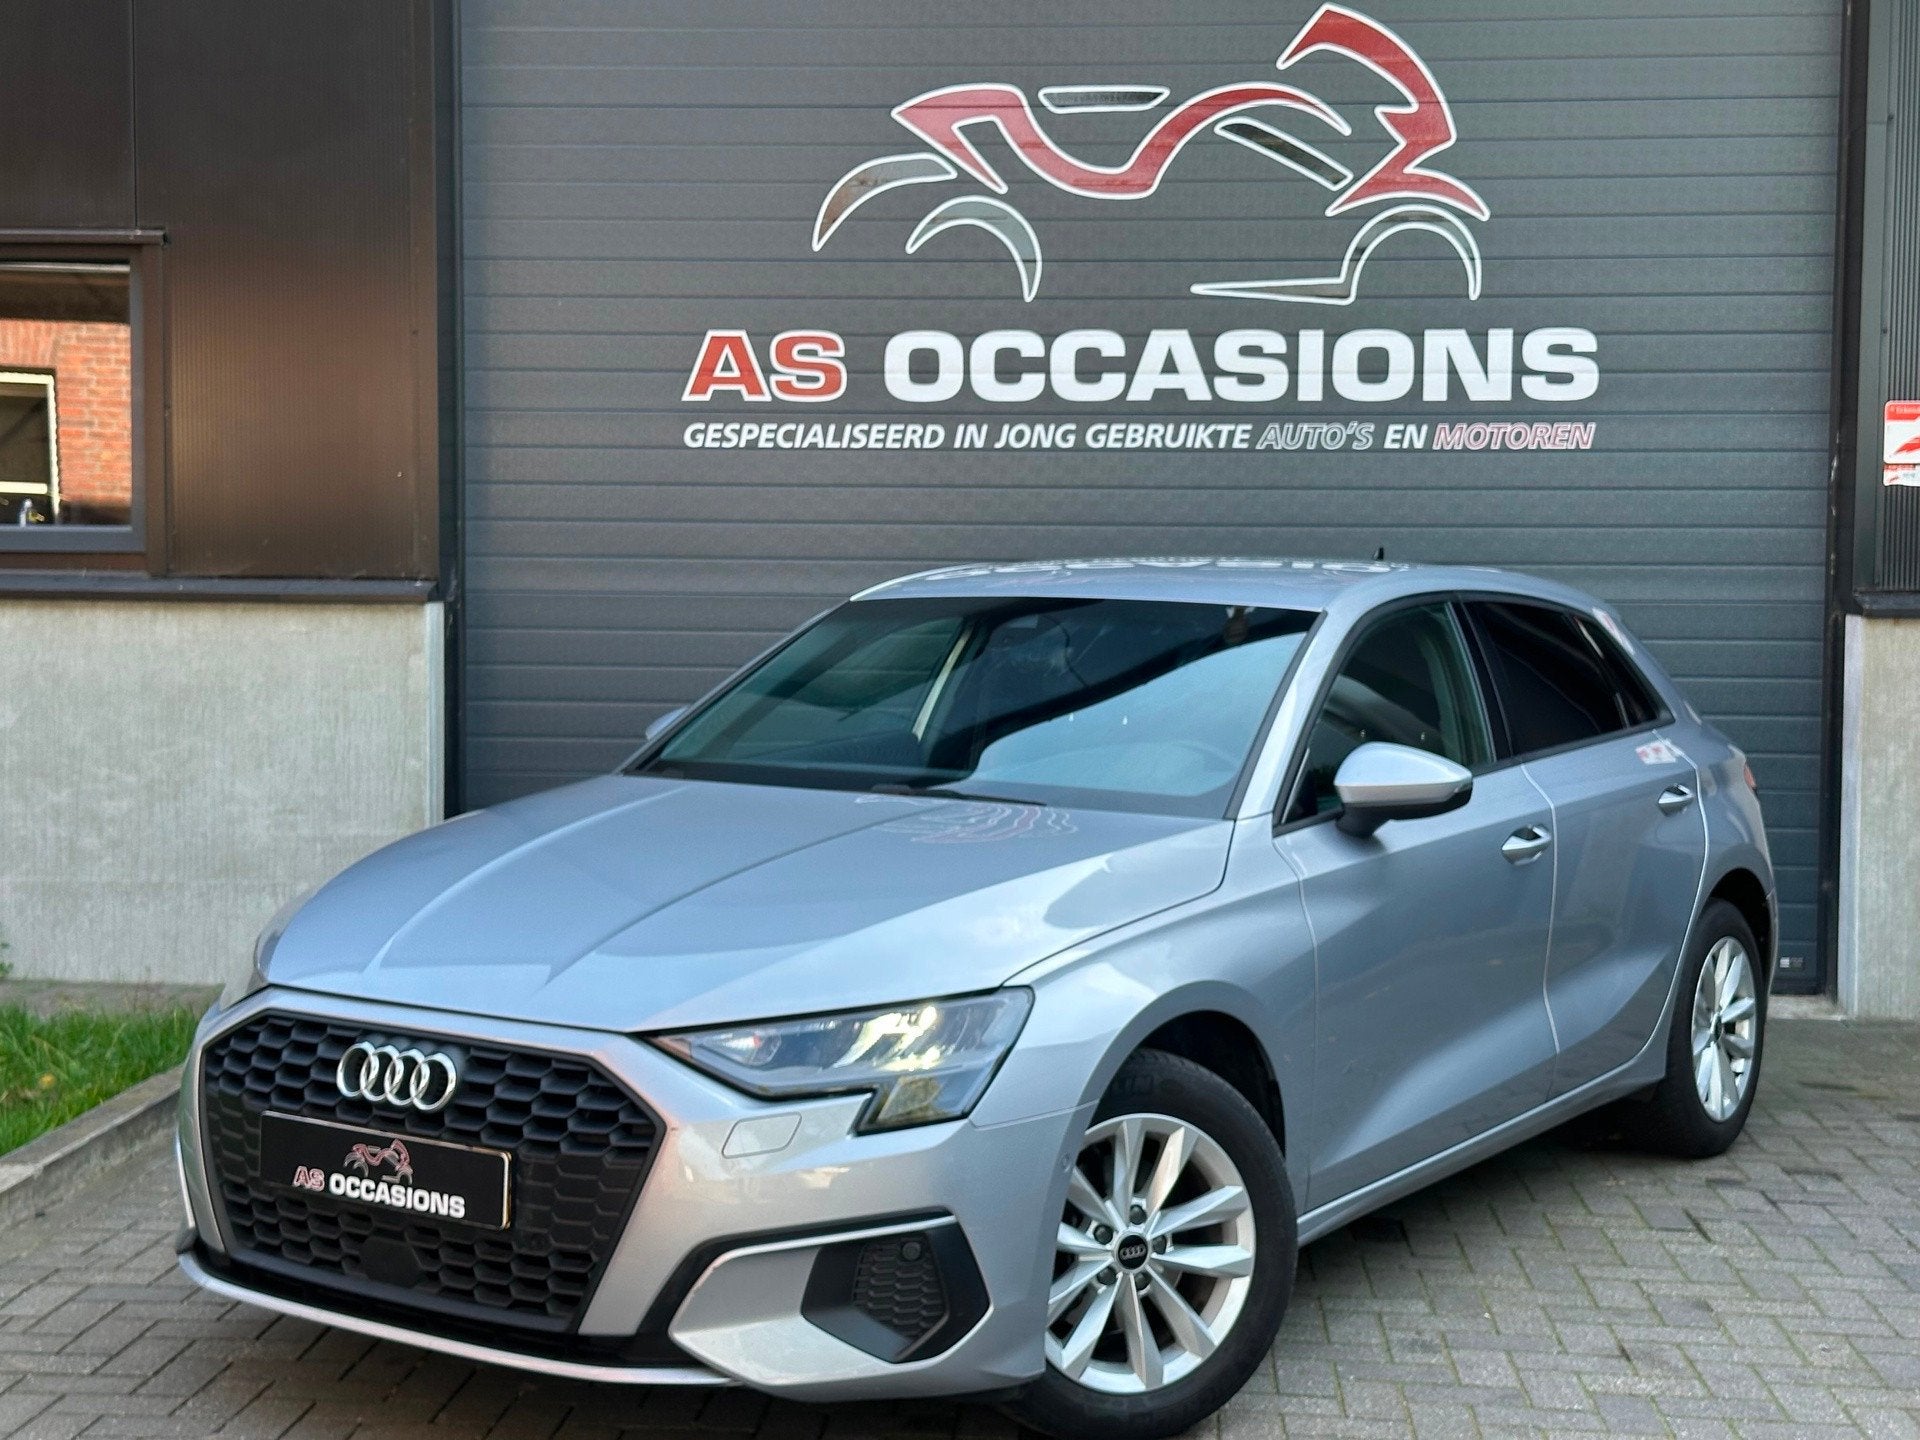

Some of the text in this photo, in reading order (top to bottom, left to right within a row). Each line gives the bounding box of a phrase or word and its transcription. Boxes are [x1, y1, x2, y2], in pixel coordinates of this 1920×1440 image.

[681, 327, 1600, 402] AS OCCASIONS
[683, 421, 1597, 449] GESPECIALISEERD IN JONG GEBRUIKTE AUTO'S EN MOTOREN
[293, 1166, 466, 1218] AS OCCASIONS
